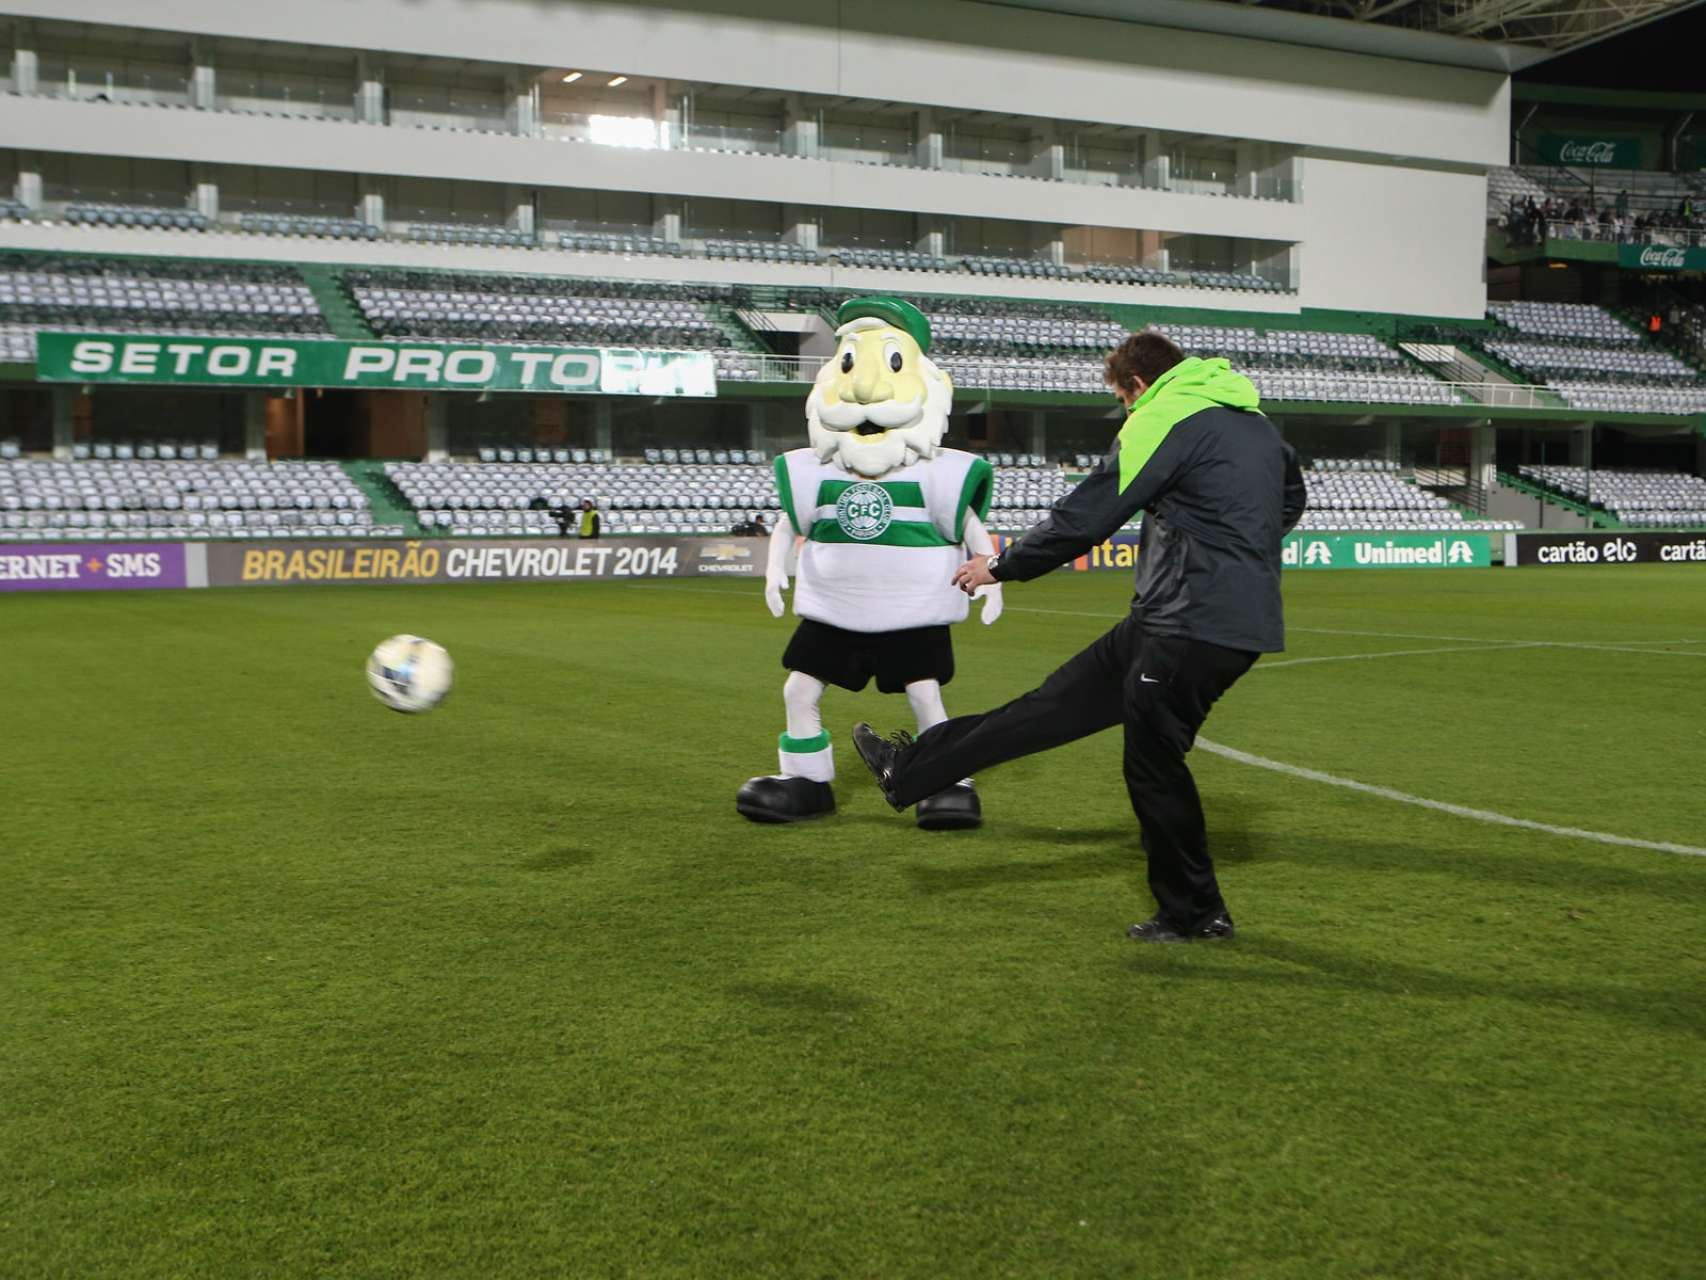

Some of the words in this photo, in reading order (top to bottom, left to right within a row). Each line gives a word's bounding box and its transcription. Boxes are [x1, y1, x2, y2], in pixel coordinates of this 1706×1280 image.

[70, 341, 298, 378] SETOR
[343, 346, 496, 385] PRO
[847, 503, 881, 518] CFC
[242, 542, 440, 581] BRASILEIRÃO
[446, 547, 613, 578] CHEVROLET
[614, 546, 679, 577] 2014
[1354, 541, 1442, 565] Unimed
[1537, 541, 1599, 563] cartão
[106, 552, 161, 578] SMS
[698, 564, 754, 573] CHEVROLET
